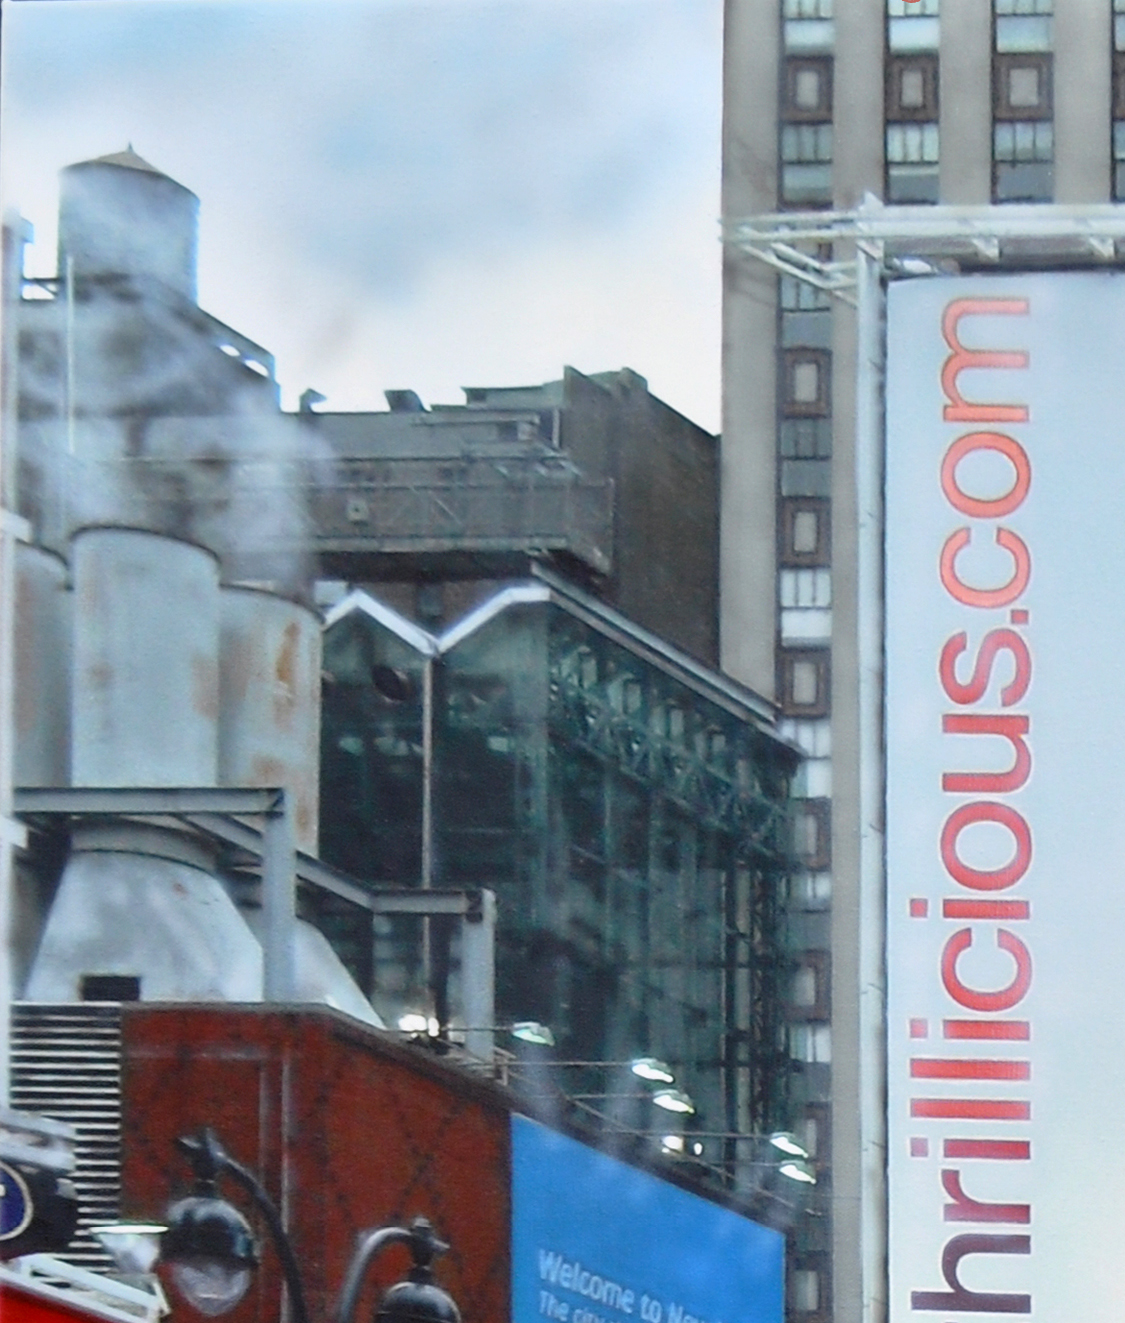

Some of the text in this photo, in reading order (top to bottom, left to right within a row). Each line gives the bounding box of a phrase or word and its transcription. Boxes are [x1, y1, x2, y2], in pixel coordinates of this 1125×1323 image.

[538, 1249, 635, 1314] Welcome
[640, 1293, 662, 1323] to
[539, 1290, 570, 1322] The
